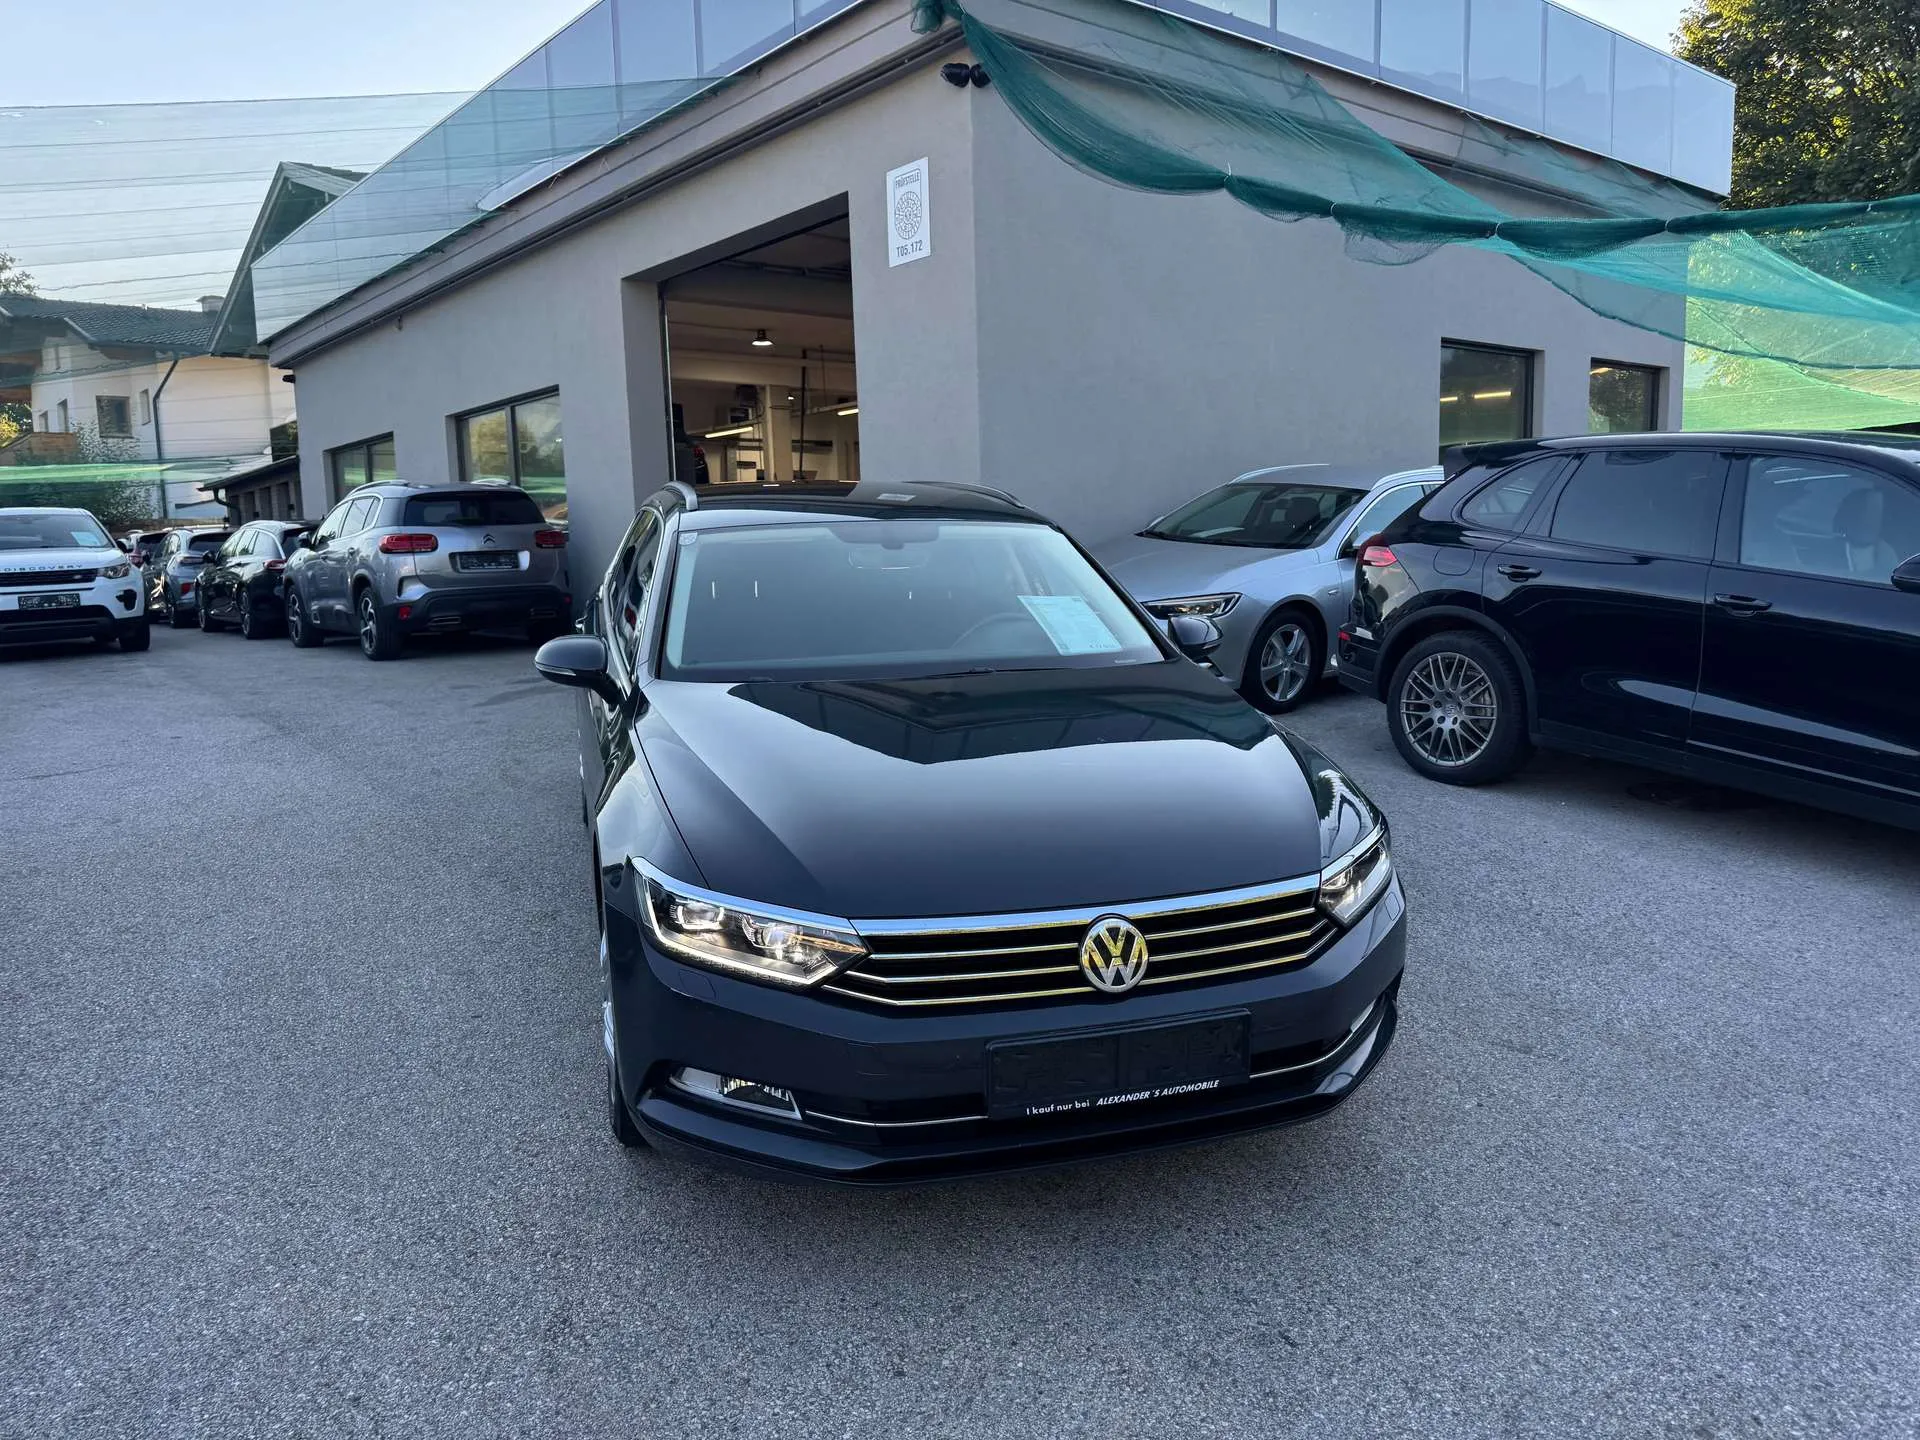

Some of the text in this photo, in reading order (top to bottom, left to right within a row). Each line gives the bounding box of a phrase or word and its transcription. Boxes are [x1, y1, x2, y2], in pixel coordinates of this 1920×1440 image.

[1032, 1104, 1054, 1115] kauf
[1057, 1103, 1073, 1112] nur
[1075, 1099, 1090, 1109] bei
[1161, 1080, 1220, 1097] AUTOMOBILE
